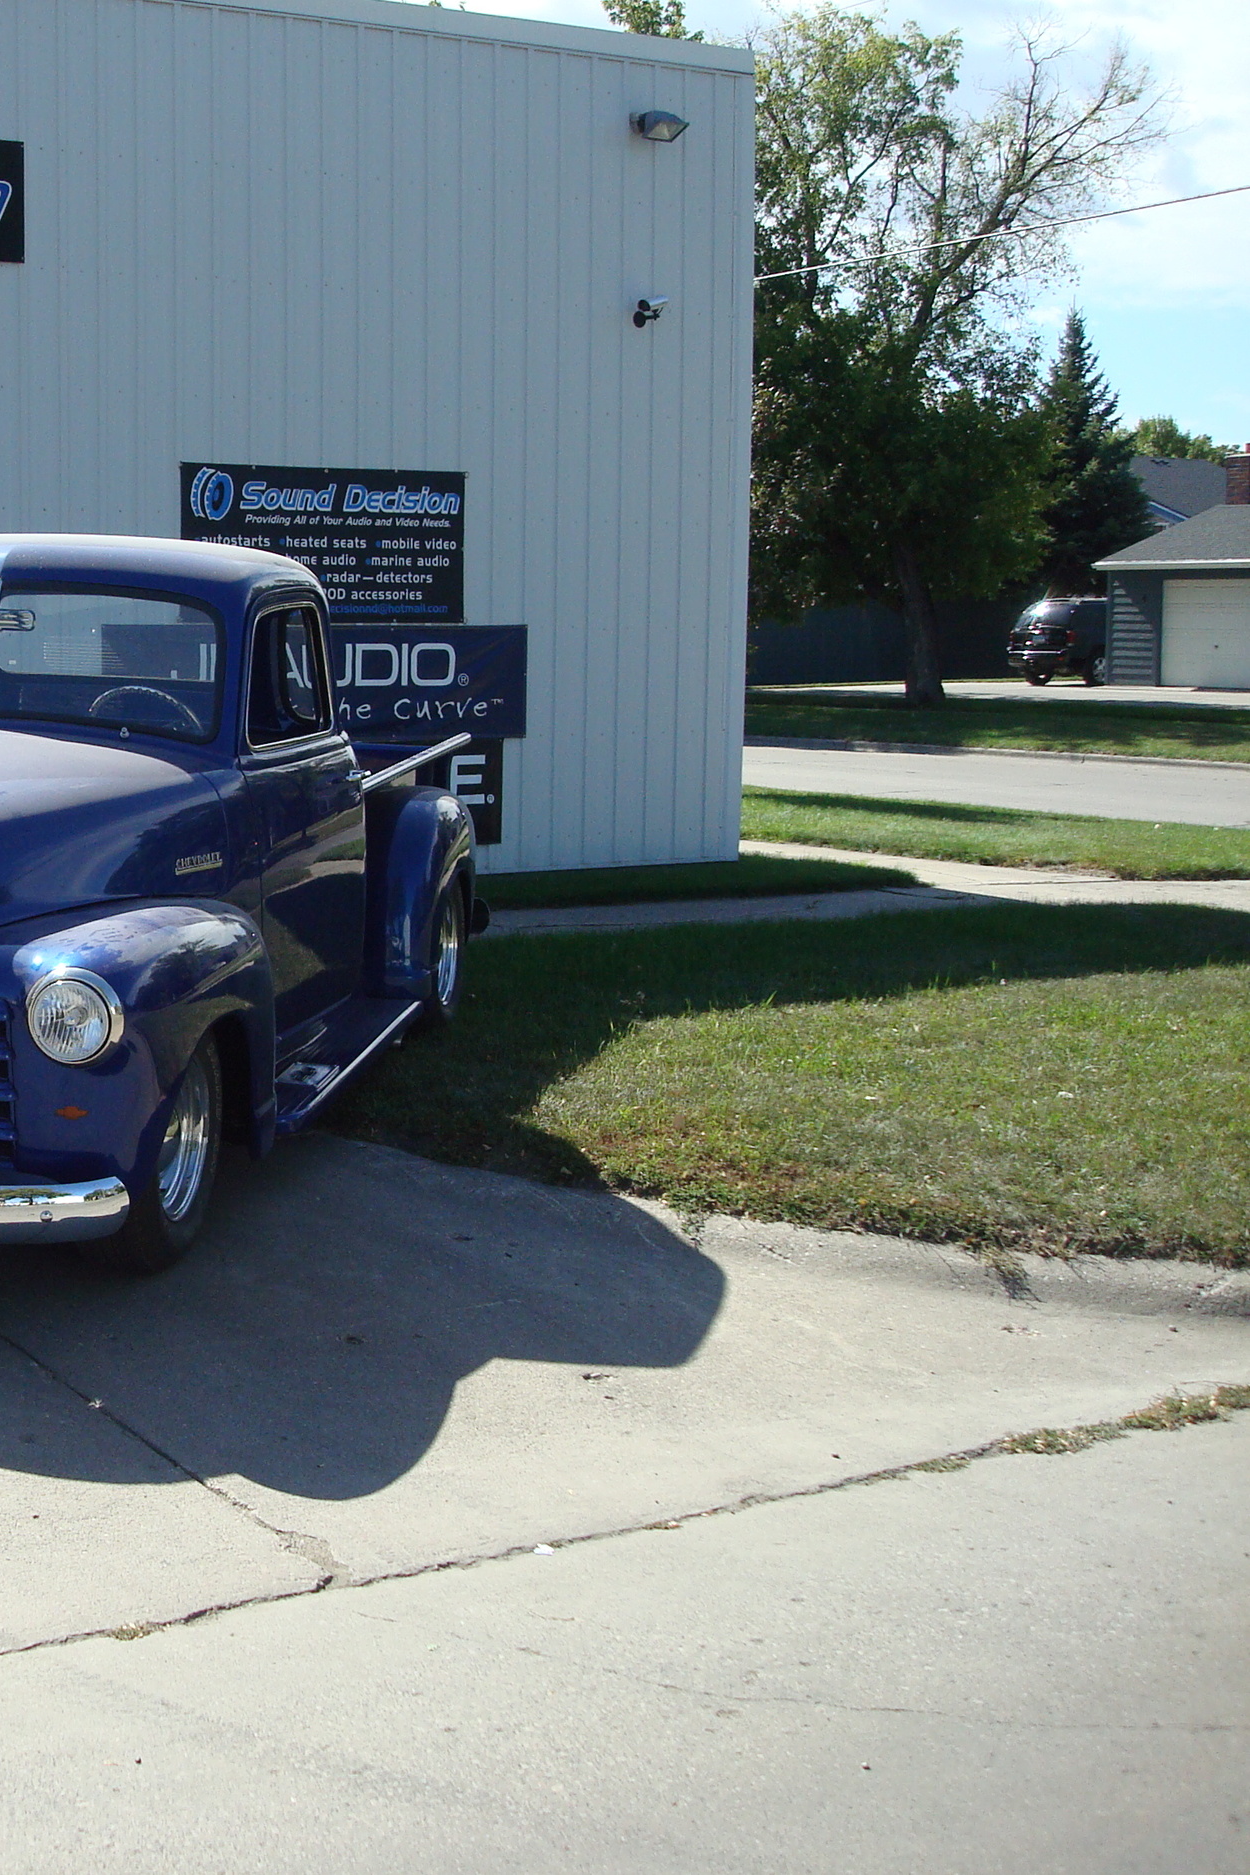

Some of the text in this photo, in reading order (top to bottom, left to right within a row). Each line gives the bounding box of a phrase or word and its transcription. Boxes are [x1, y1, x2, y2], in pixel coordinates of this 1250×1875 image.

[240, 481, 461, 515] Sound Decision
[245, 514, 291, 526] Providing
[293, 516, 307, 525] All
[309, 517, 320, 526] of
[323, 516, 343, 526] Your
[345, 516, 372, 527] Audio
[375, 518, 392, 527] and
[395, 518, 419, 528] Video
[201, 534, 457, 550] autostarts heated seats mobile video
[322, 554, 357, 566] audio
[371, 555, 412, 567] marine
[417, 555, 450, 567] audio
[351, 588, 423, 601] accessories
[338, 697, 371, 720] he
